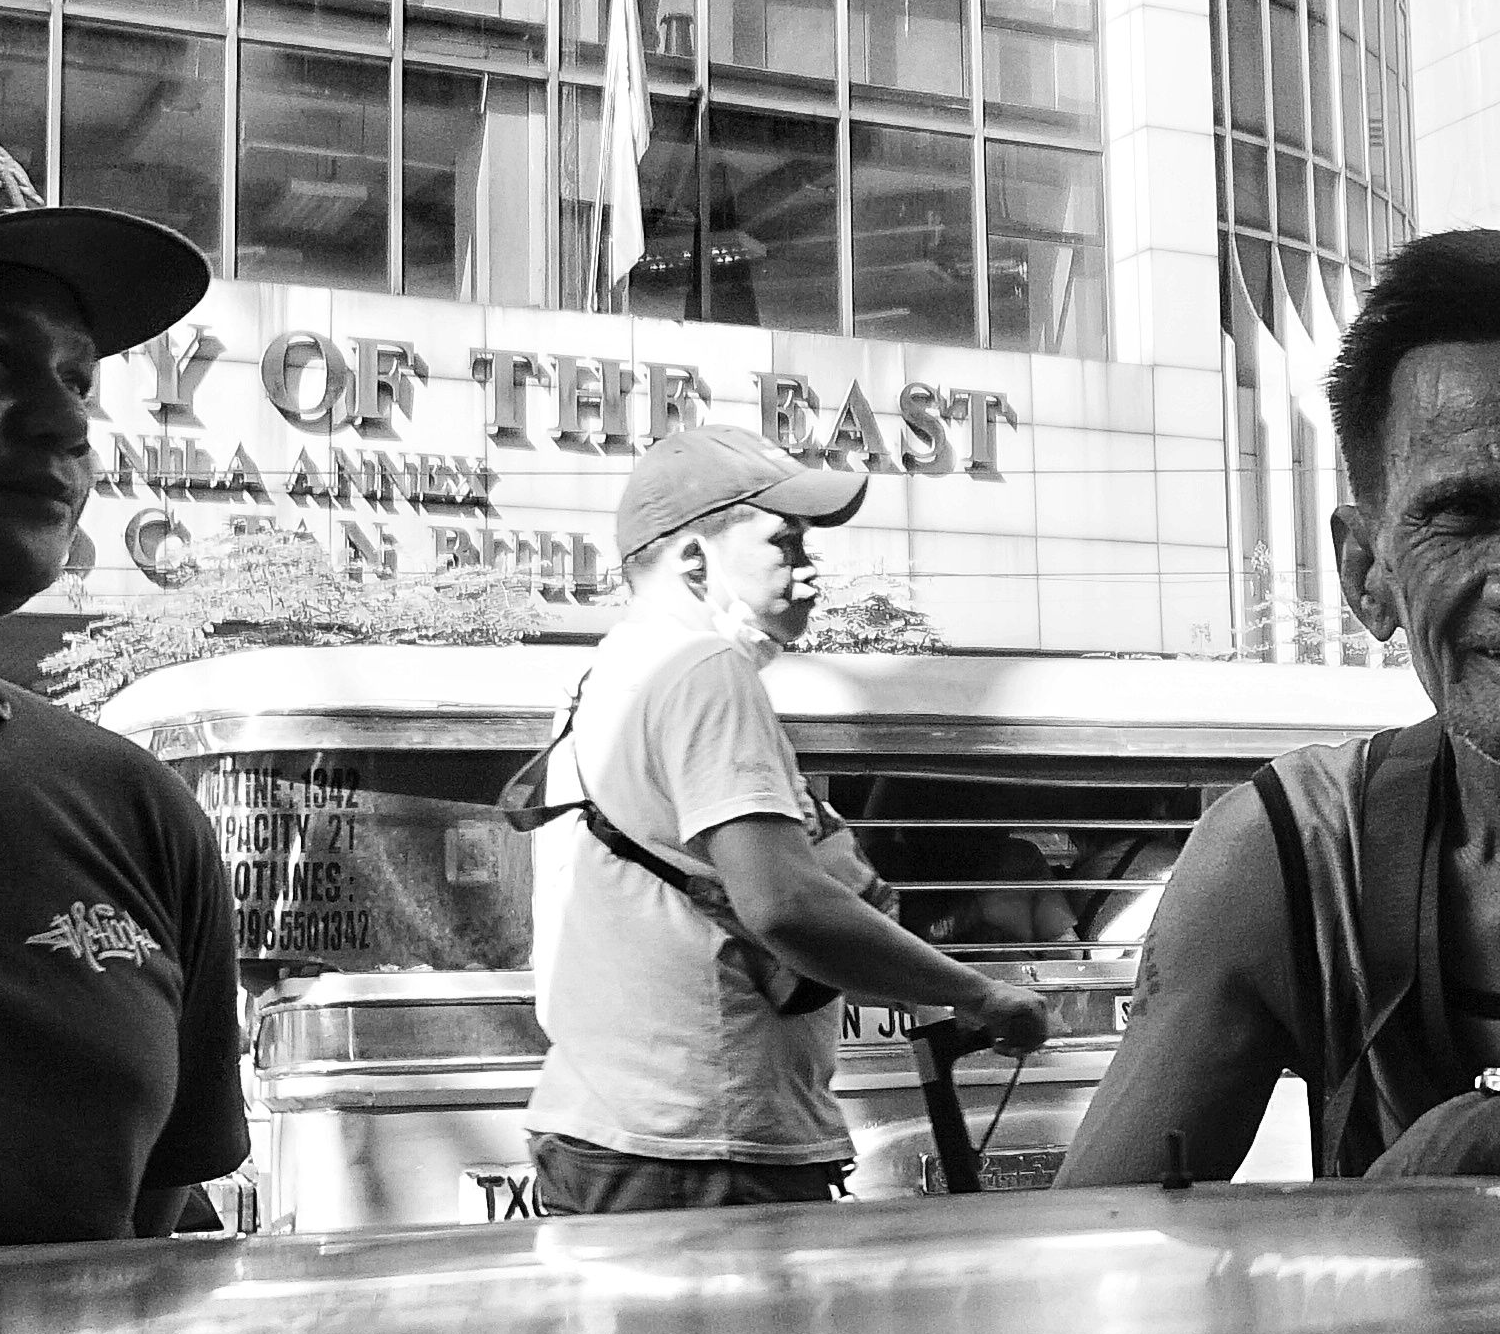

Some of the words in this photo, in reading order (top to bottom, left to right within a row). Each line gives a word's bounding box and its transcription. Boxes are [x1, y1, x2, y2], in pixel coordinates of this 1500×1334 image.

[260, 329, 428, 440] OF
[468, 347, 712, 455] THE
[750, 371, 1019, 482] EAST
[96, 433, 275, 505] NILA
[285, 445, 502, 518] ANNEX
[303, 767, 359, 809] 1342
[214, 813, 310, 854] PACITY
[328, 814, 356, 854] 21
[233, 860, 355, 903] OTLINES:
